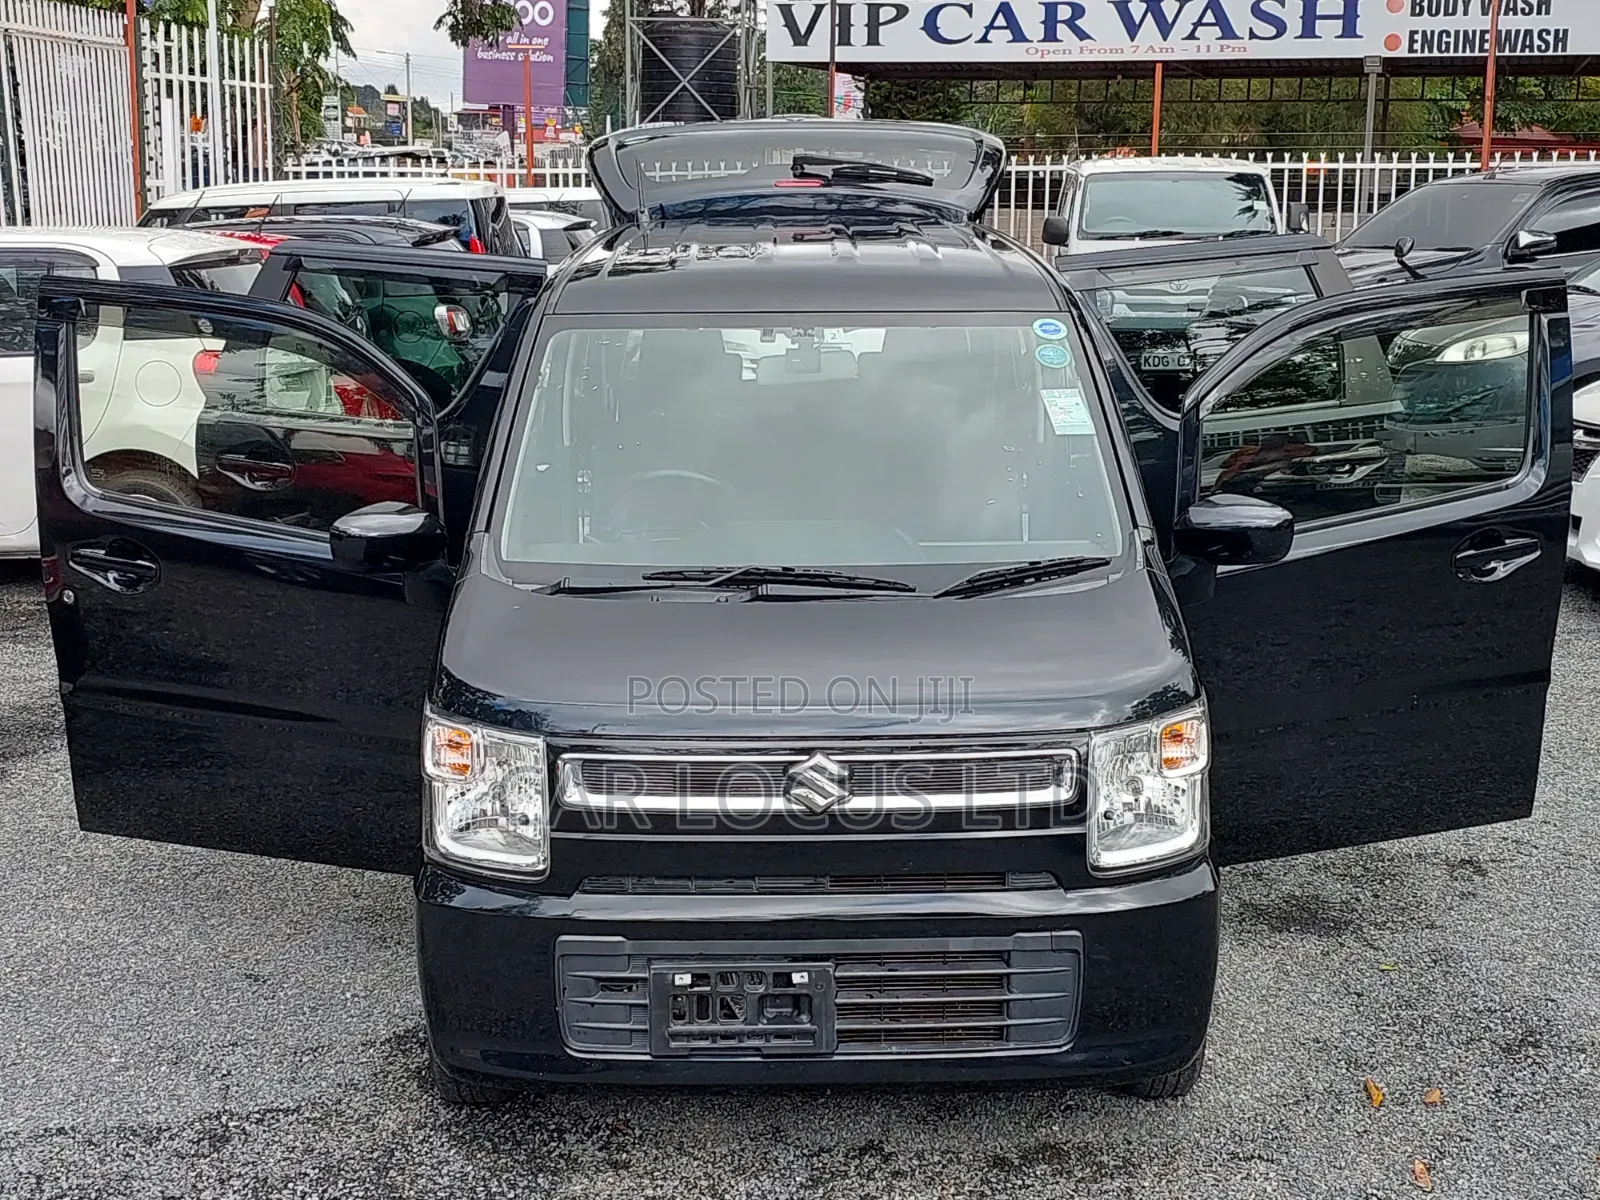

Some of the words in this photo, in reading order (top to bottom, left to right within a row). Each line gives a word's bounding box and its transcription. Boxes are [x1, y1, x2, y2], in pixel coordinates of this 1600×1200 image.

[1410, 0, 1472, 17] BODY
[1480, 0, 1552, 16] WASH
[773, 3, 909, 47] VIP
[919, 2, 1097, 45] CAR
[1106, 0, 1364, 43] WASH
[506, 32, 519, 44] all
[520, 34, 530, 44] in
[531, 36, 550, 46] one
[1407, 29, 1491, 53] ENGINE
[1496, 28, 1569, 53] WASH
[476, 47, 516, 61] business
[1025, 45, 1073, 59] Open
[1077, 43, 1125, 55] From
[1130, 44, 1140, 54] 7
[1143, 43, 1176, 54] Am
[1194, 44, 1213, 54] 11
[1219, 43, 1248, 54] Pm
[1143, 354, 1170, 368] KDG
